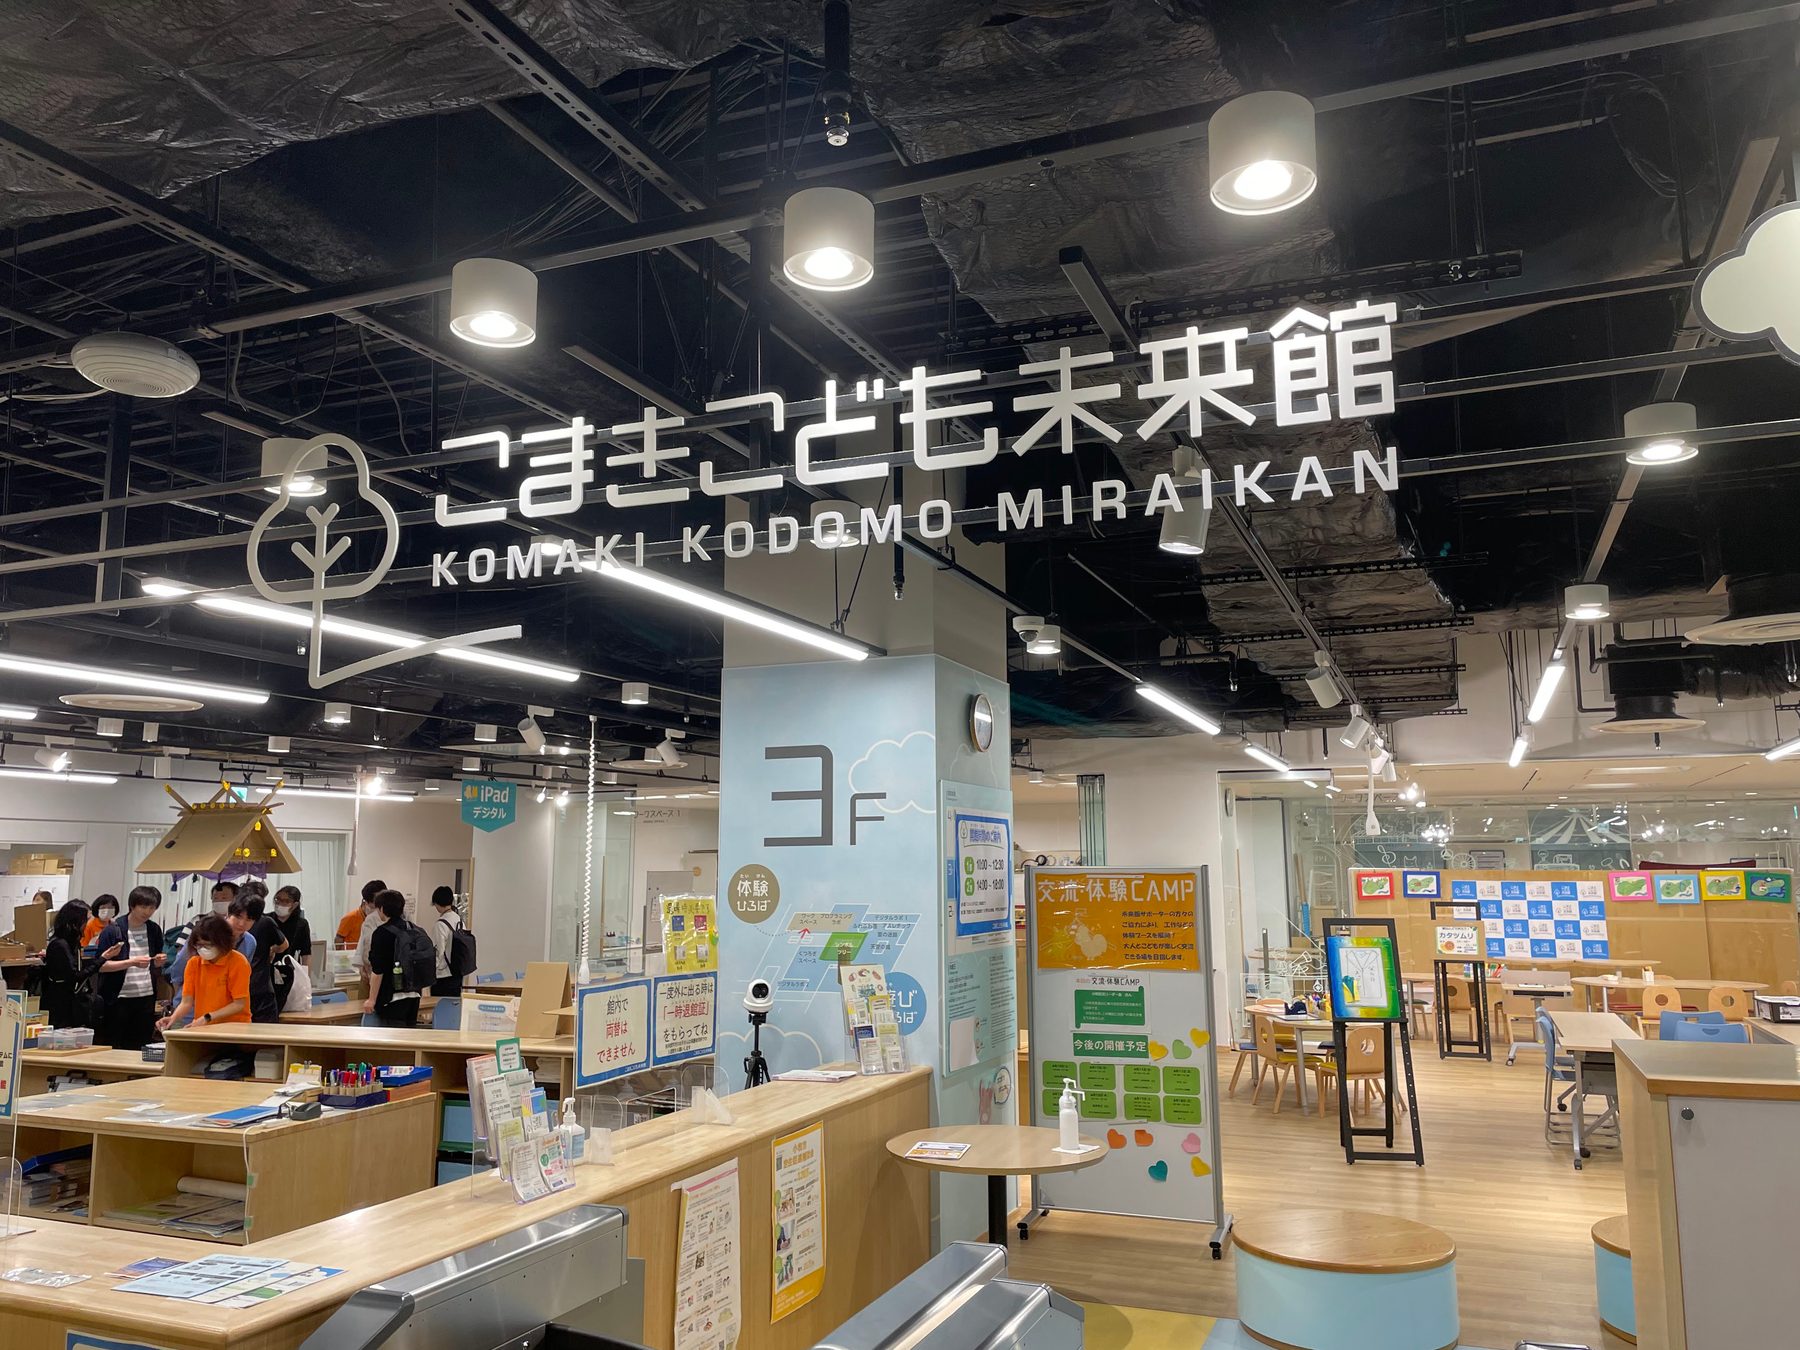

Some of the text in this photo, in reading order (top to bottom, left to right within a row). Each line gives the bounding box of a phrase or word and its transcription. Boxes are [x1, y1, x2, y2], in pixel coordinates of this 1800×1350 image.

[435, 300, 1398, 527] こまきこども未来館
[432, 445, 1399, 588] KOMAKI KODOMO MIRAIKAN
[480, 785, 509, 803] iPad
[473, 806, 507, 819] デジタル
[737, 880, 769, 897] 体験
[1038, 879, 1194, 903] 交流・体験CAMP
[737, 900, 771, 911] ひろば
[1439, 932, 1474, 940] カタツムリ
[659, 983, 714, 1000] 一度外に出る時は
[606, 998, 629, 1016] 館内で
[606, 1021, 628, 1040] 両替は
[663, 1022, 709, 1042] をもらってね
[597, 1042, 636, 1063] できません
[1073, 1039, 1148, 1053] 今後の開催予定
